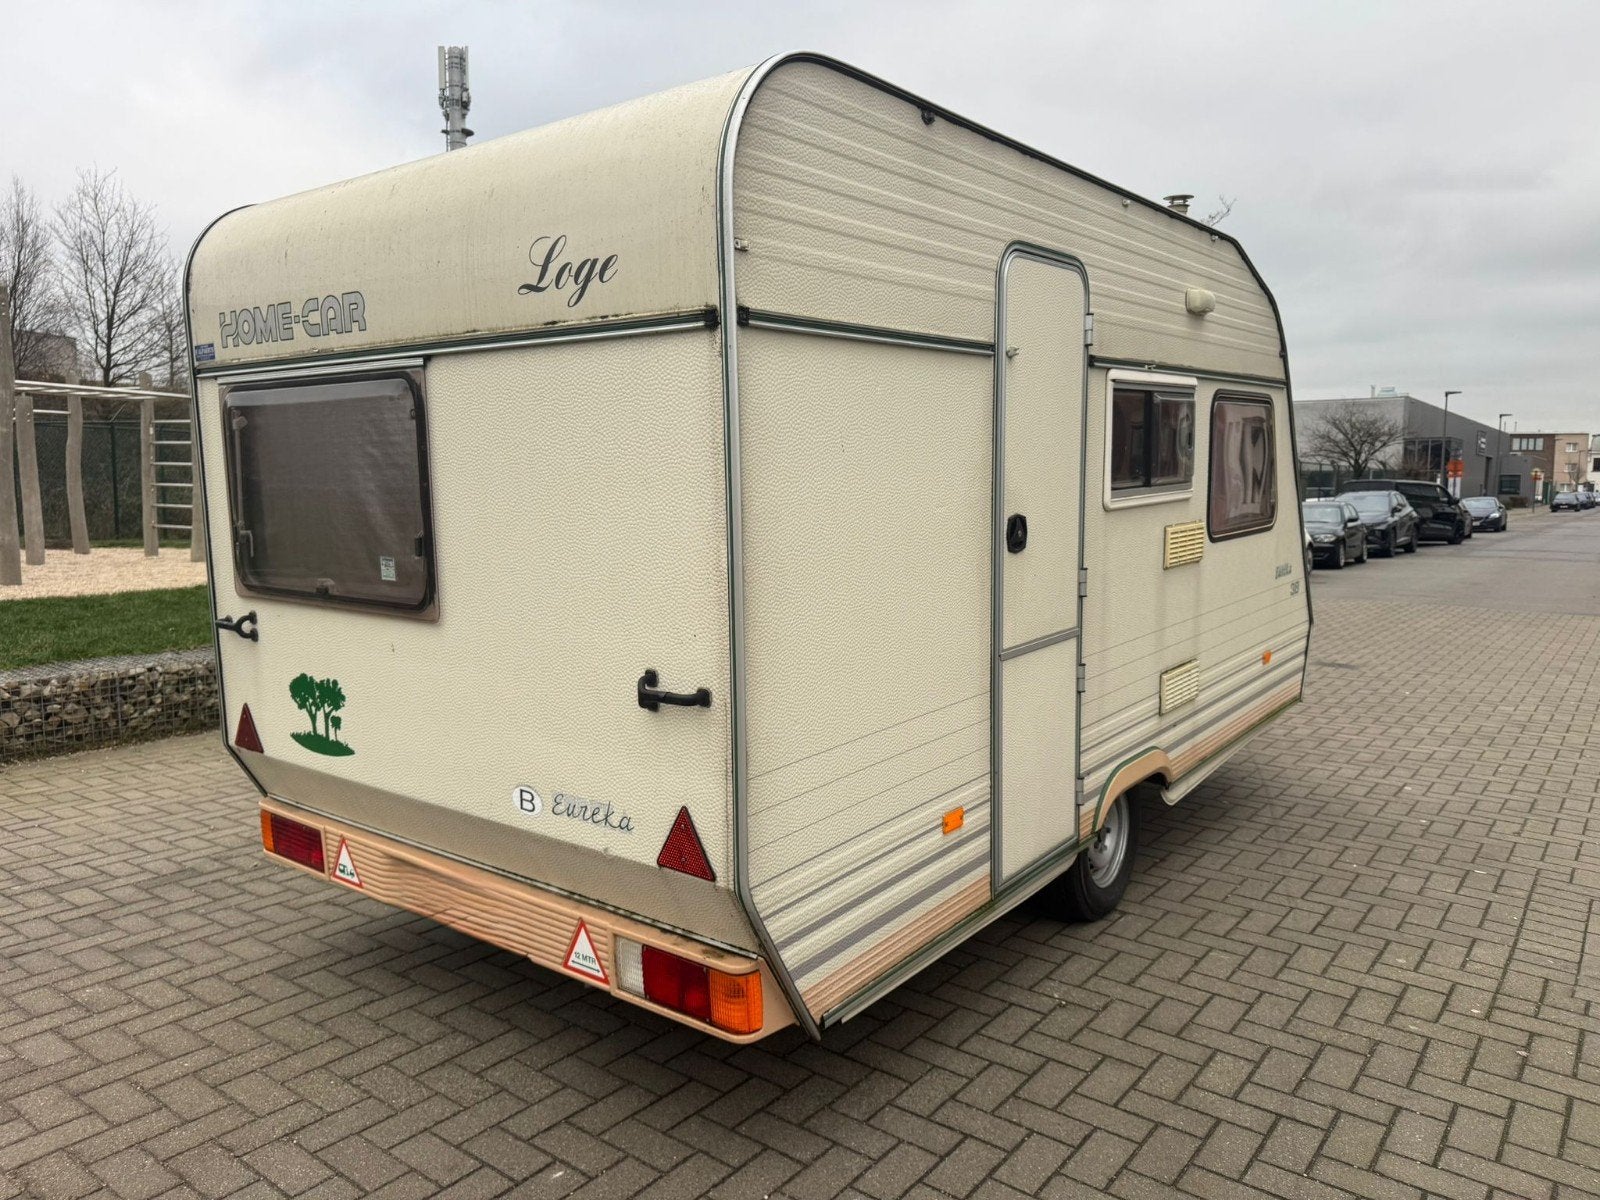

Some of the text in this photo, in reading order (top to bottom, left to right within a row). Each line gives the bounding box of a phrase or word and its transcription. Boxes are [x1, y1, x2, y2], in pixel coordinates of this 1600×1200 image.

[517, 234, 619, 308] Loge
[219, 290, 367, 349] HOME-CAR
[520, 788, 535, 813] B
[551, 792, 635, 832] Eureka
